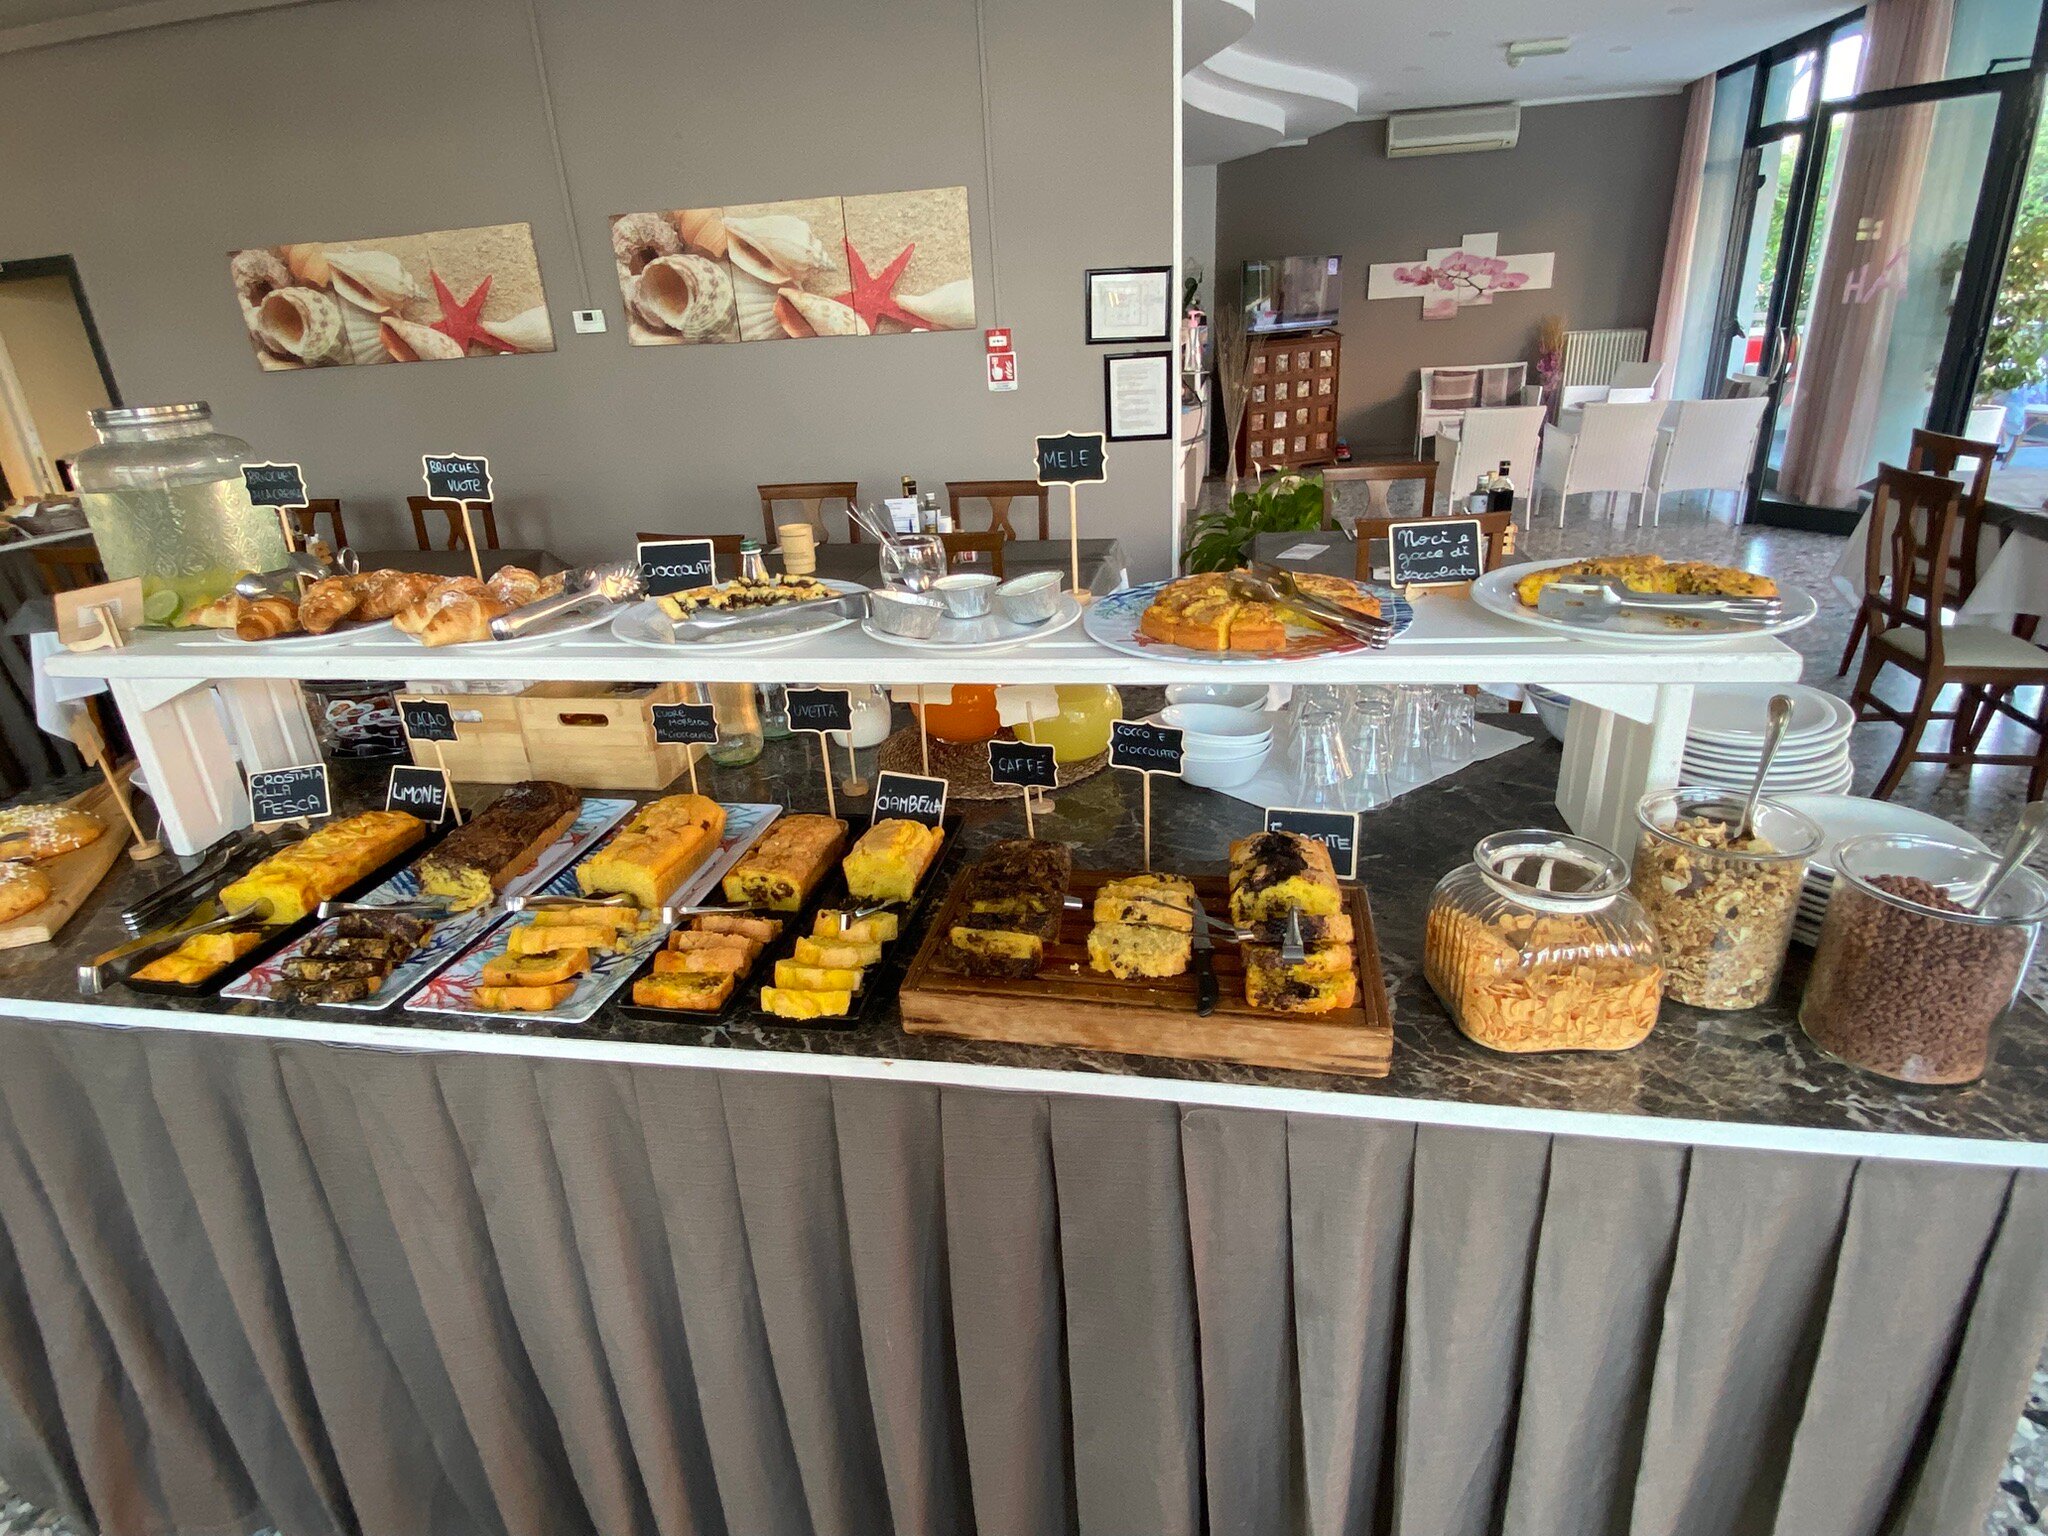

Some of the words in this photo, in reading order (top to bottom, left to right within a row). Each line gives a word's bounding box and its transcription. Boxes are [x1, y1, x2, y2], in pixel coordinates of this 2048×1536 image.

[429, 460, 480, 474] BRIOCHES
[1043, 449, 1090, 469] MELE
[447, 478, 482, 492] VUOTE
[1397, 529, 1452, 548] Noci
[1457, 533, 1470, 544] e
[1398, 549, 1444, 570] gocce
[1450, 545, 1470, 557] di
[408, 710, 448, 728] CACAO
[793, 703, 839, 718] UVETTA
[1117, 725, 1151, 739] COCCO
[1118, 743, 1180, 760] CIOCCOLATO
[251, 767, 324, 789] CROSTATA
[253, 784, 292, 800] ALLA
[393, 782, 442, 805] LIMONE
[259, 794, 321, 815] PESCA
